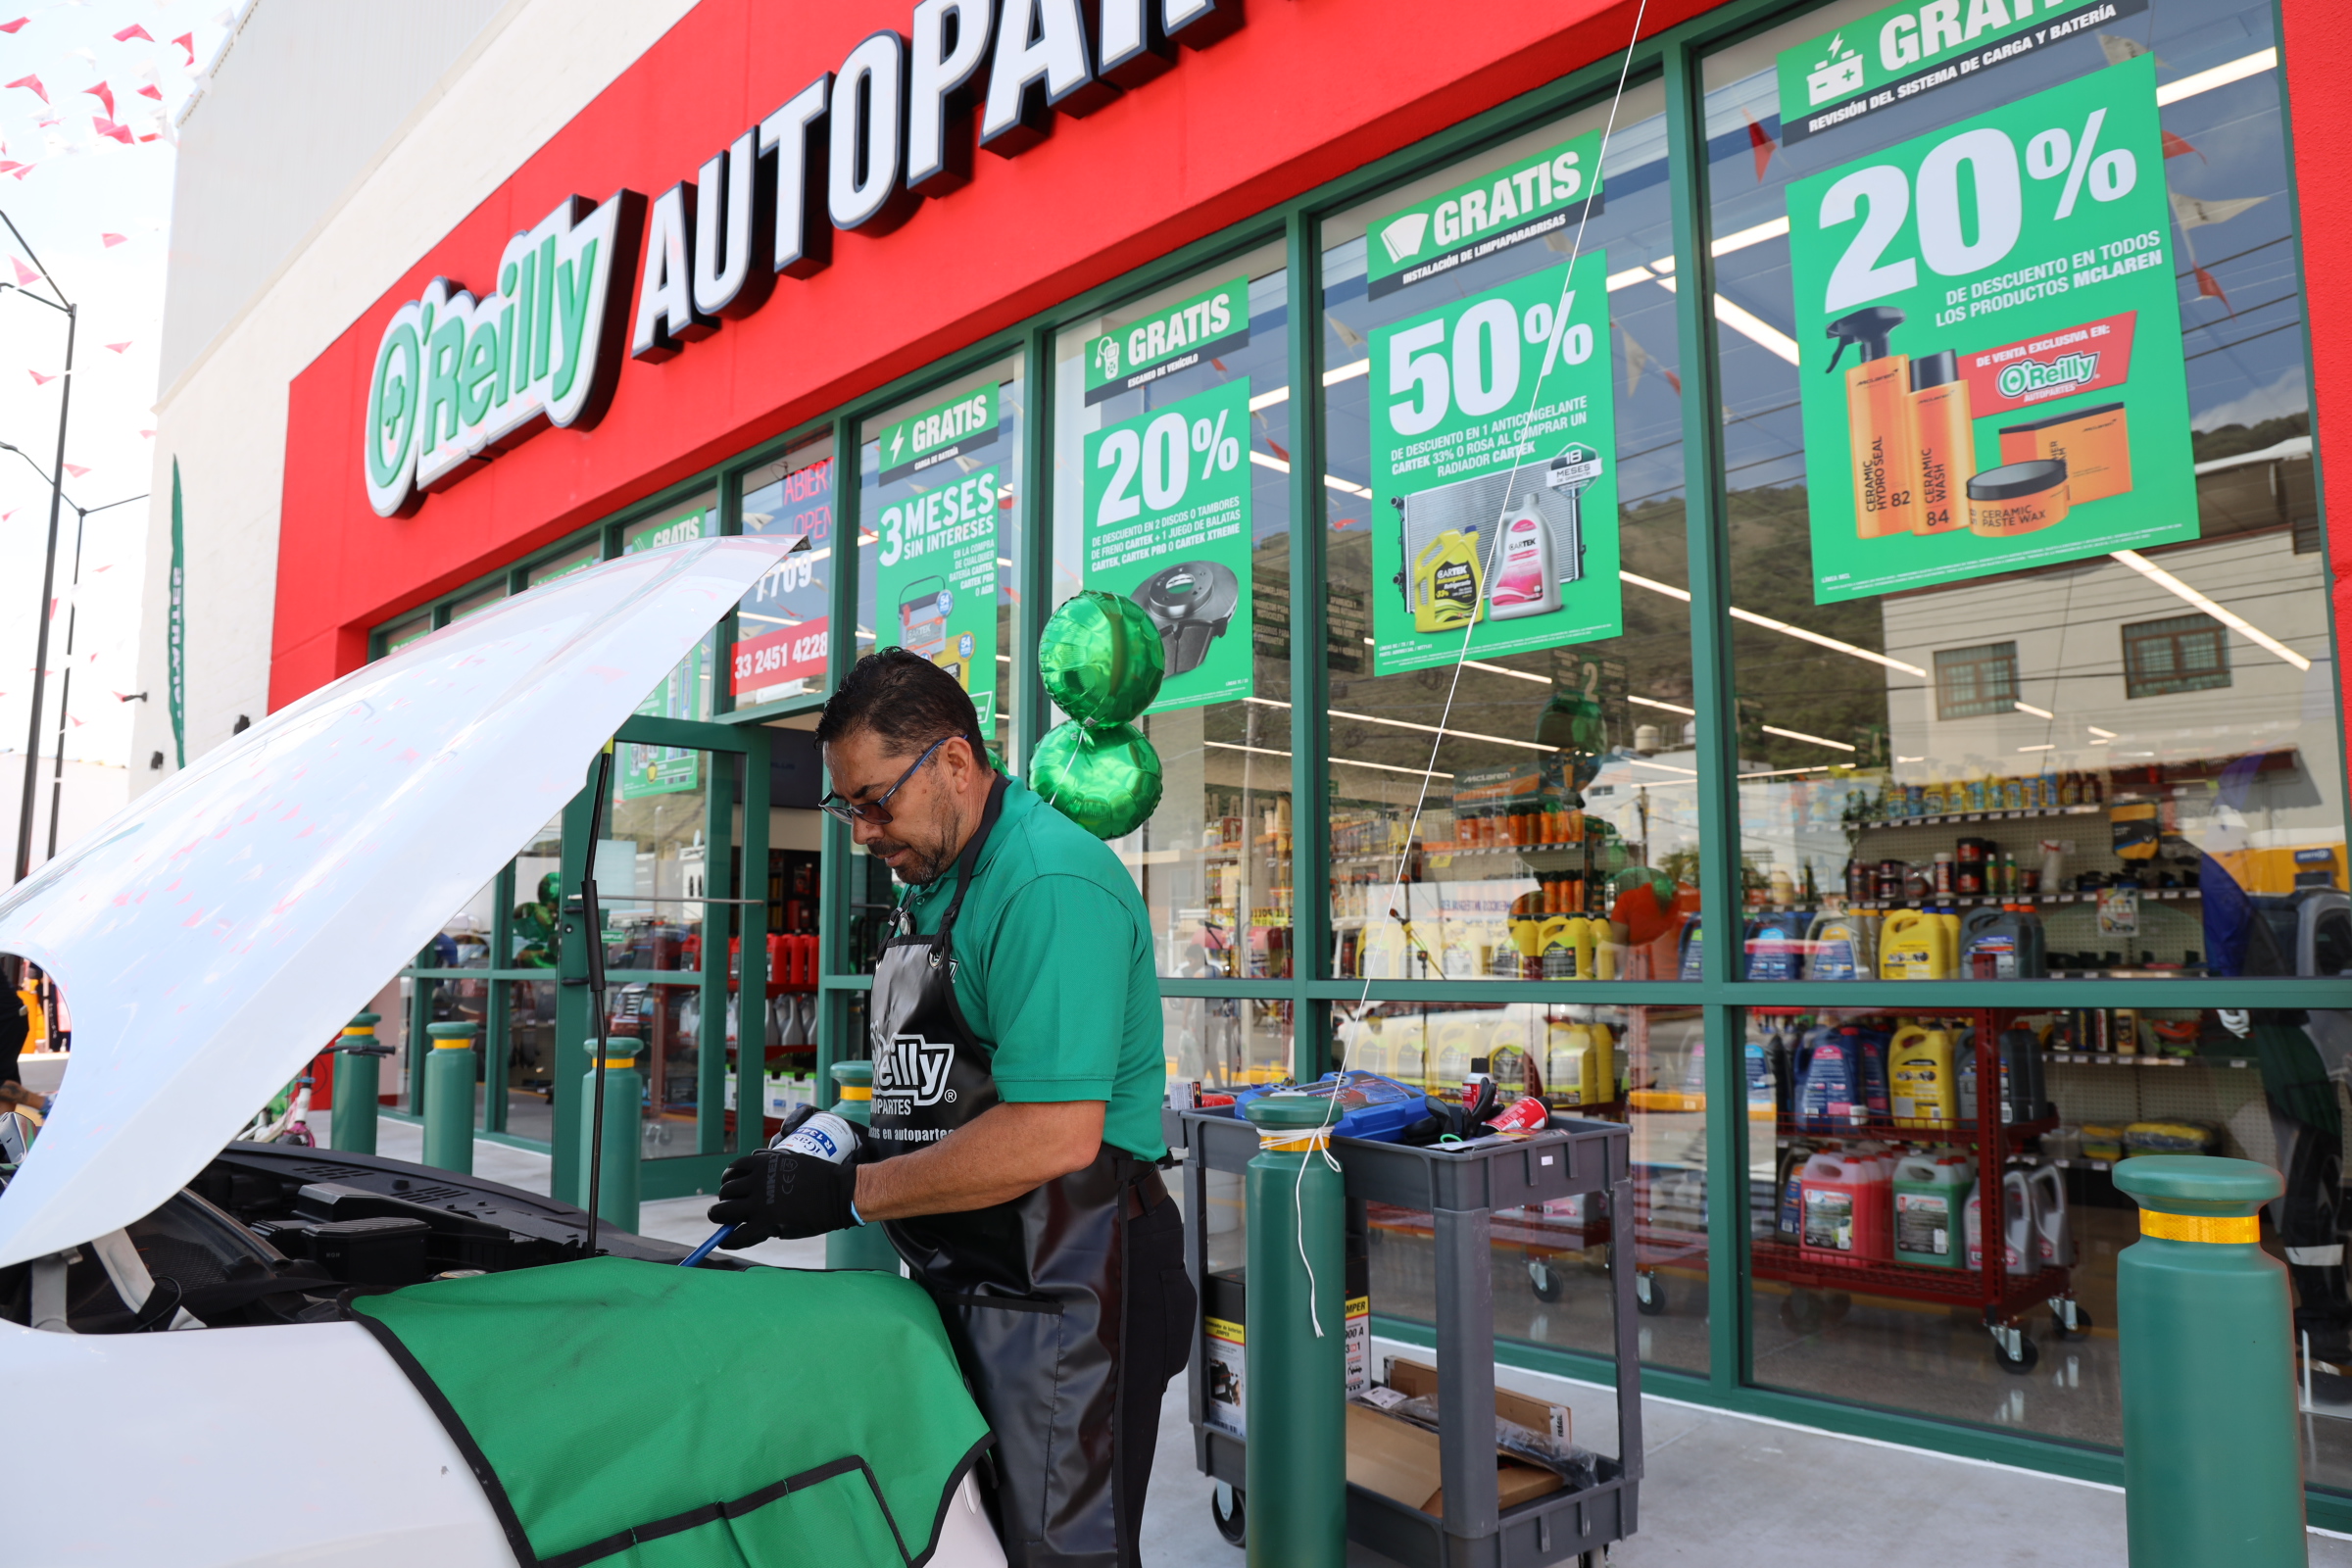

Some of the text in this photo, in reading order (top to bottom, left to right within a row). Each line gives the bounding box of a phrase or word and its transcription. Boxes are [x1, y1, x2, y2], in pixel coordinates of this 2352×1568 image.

[1808, 3, 2116, 132] REVISIÓN DEL SISTEMA DE CARGA Y BATERÍA
[1434, 151, 1581, 246] GRATIS
[1818, 107, 2136, 314] 20%
[1402, 214, 1566, 284] INSTALACIÓN DE LIMPIAPARABRISAS
[1945, 229, 2161, 306] DE DESCUENTO EN TODOS
[1936, 249, 2163, 327] LOS PRODUCTOS MCLAREN
[1128, 293, 1230, 366] GRATIS
[1976, 324, 2111, 368] DE VENTA EXCLUSIVA EN:
[367, 211, 614, 505] O'Reilly
[1128, 353, 1199, 388] ESCANEO DE VEHÍCULO
[1389, 289, 1593, 436] 50%
[1998, 353, 2097, 396] O'Reilly
[2024, 383, 2076, 403] AUTOPARTES
[911, 394, 987, 453] GRATIS
[1391, 395, 1588, 462] DE DESCUENTO EN 1 ANTICONGELANTE
[1392, 411, 1587, 475] CARTEK 33% O ROSA AL COMPRAR UN
[914, 446, 958, 471] CARGA DE BATERÍA
[1096, 409, 1239, 527] 20%
[1437, 441, 1536, 477] RADIADOR CARTEK
[1556, 464, 1591, 478] MESES
[1565, 449, 1583, 465] 18
[1872, 436, 1886, 511] HYDRO SEAL
[1922, 448, 1936, 504] CERAMIC
[1863, 460, 1876, 513] CERAMIC
[1891, 491, 1911, 508] 82
[1934, 464, 1947, 503] WASH
[905, 472, 995, 540] MESES
[1093, 496, 1240, 548] DE DESCUENTO EN 2 DISCOS O TAMBORES
[1927, 509, 1950, 526] 84
[1982, 505, 2033, 518] CERAMIC
[1983, 516, 2016, 527] PASTE
[2020, 510, 2046, 524] WAX
[879, 507, 903, 566] 3
[904, 514, 994, 561] SIN INTERESES
[954, 538, 995, 560] EN LA COMPRA
[1091, 549, 1101, 560] DE
[1102, 542, 1124, 558] FRENO
[1125, 533, 1153, 551] CARTEK
[1162, 529, 1166, 540] 1
[1168, 522, 1193, 539] JUEGO
[1194, 518, 1204, 531] DE
[1206, 509, 1241, 528] BALATAS
[1092, 522, 1240, 572] CARTEK, CARTEK PRO O CARTEK XTREME
[1508, 537, 1537, 551] CARTEK
[949, 565, 971, 582] BATERÍA
[955, 550, 995, 570] DE CUALQUIER
[960, 571, 995, 590] CARTEK PRO
[1437, 564, 1468, 579] CARTEK
[940, 594, 950, 606] 54
[975, 583, 995, 597] O AGM
[906, 622, 932, 639] CARTEK
[960, 636, 971, 648] 54
[734, 631, 828, 680] 33 2451 4228
[1464, 771, 1510, 783] McLaren
[871, 1035, 948, 1100] Reilly
[883, 1128, 892, 1140] en
[1346, 1300, 1366, 1315] MPER
[1357, 1342, 1361, 1351] 1
[1358, 1326, 1364, 1337] A
